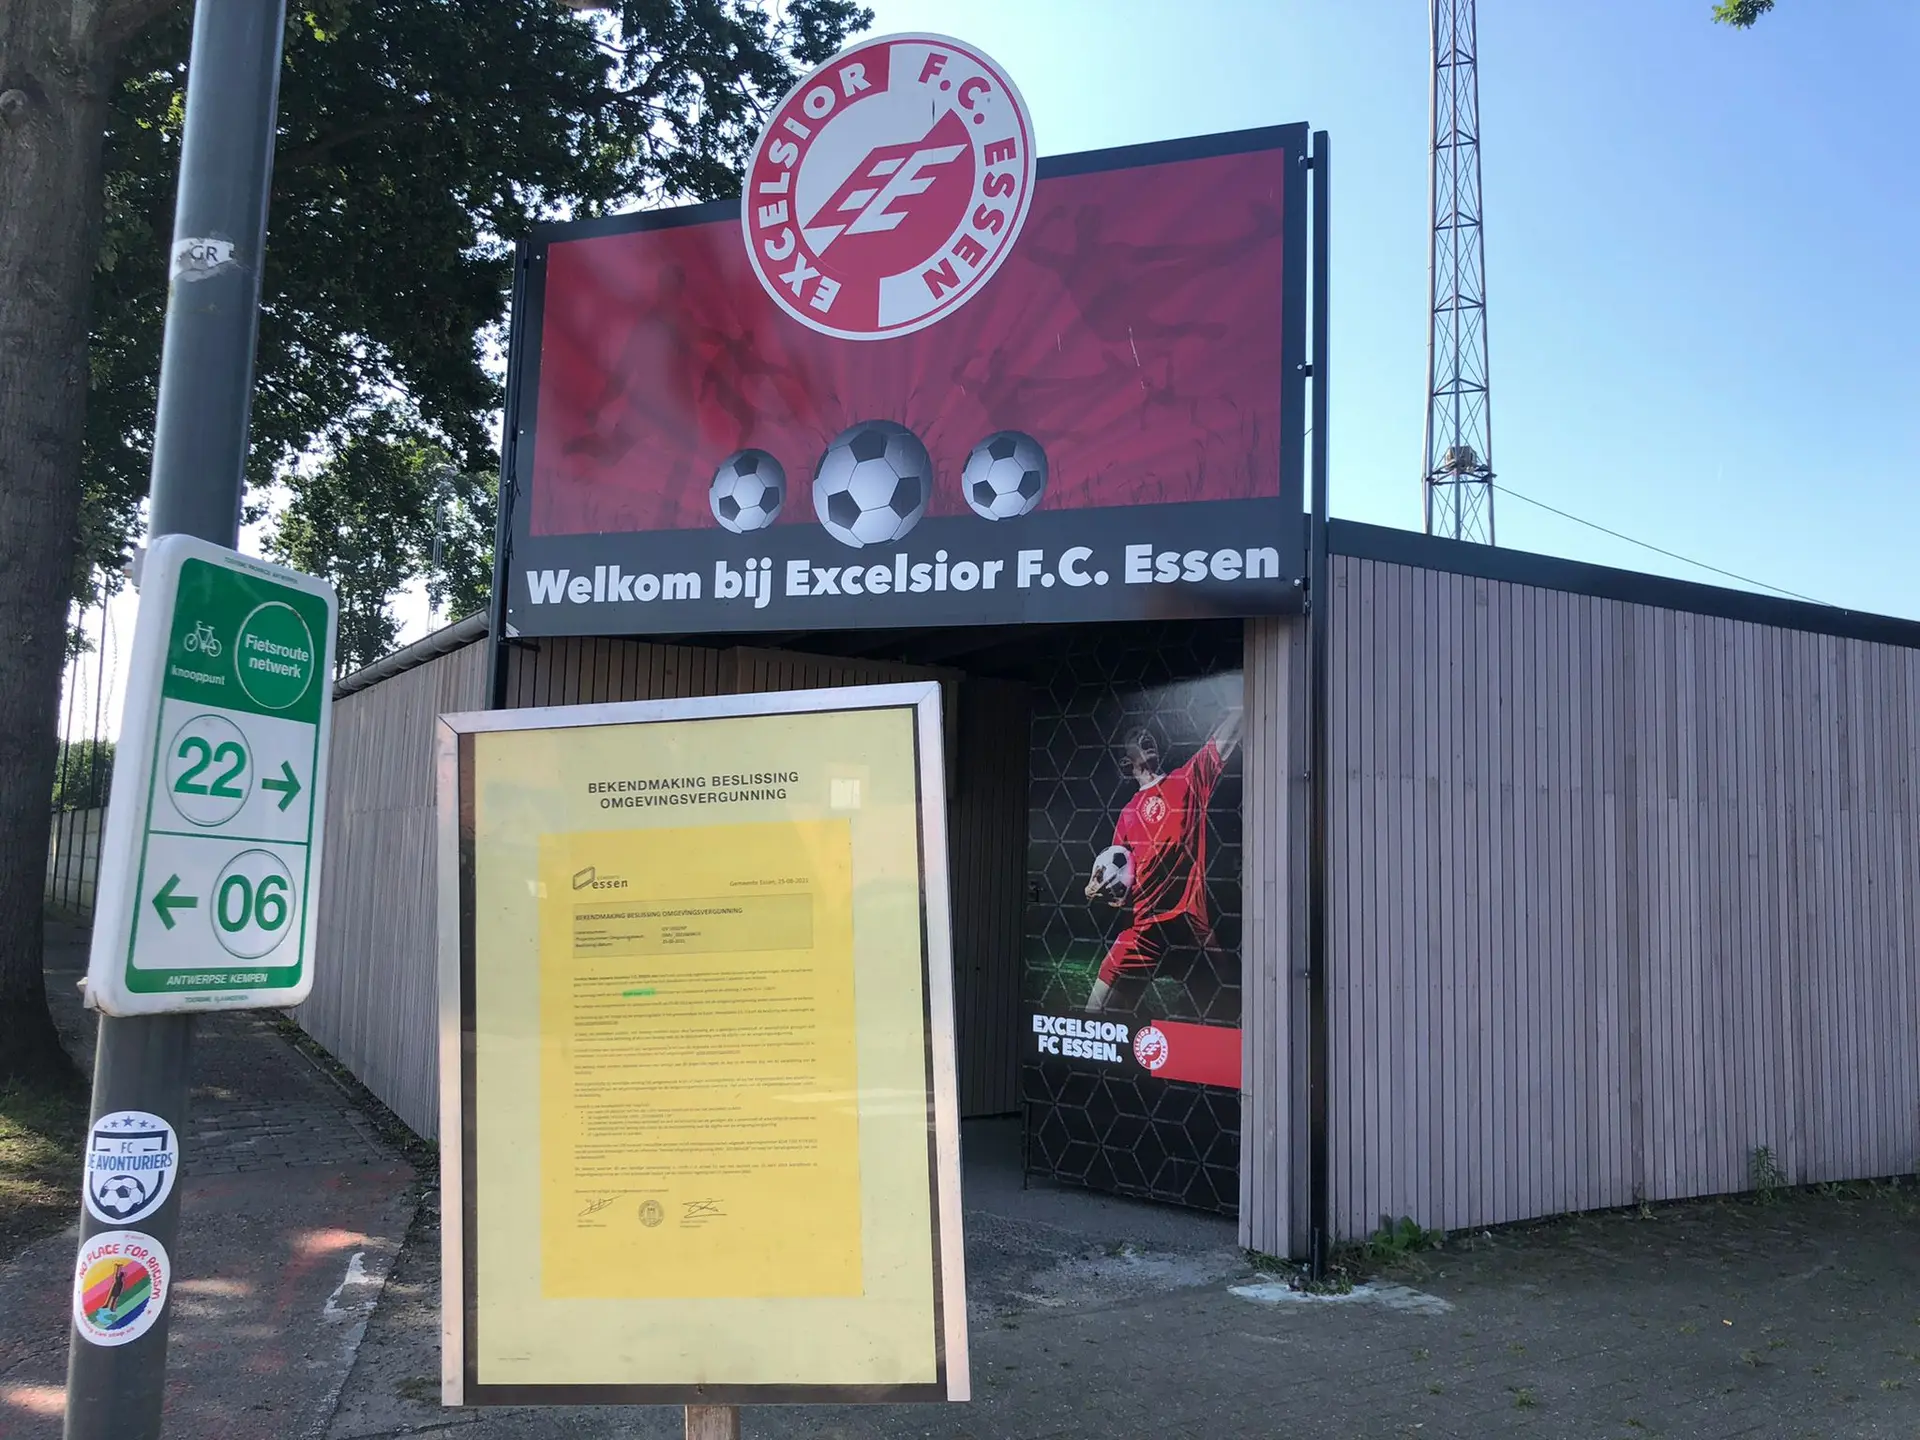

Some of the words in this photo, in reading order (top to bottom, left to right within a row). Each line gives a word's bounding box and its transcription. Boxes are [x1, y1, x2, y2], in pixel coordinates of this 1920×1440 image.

[918, 52, 991, 125] F.C.
[758, 62, 872, 314] EXCELSIOR
[922, 137, 1016, 300] ESSEN
[526, 564, 701, 605] Welkom
[714, 556, 773, 609] bij
[785, 549, 1004, 597] Excelsior
[1017, 546, 1110, 588] F.C.
[1124, 543, 1280, 585] Essen
[245, 633, 309, 662] Fietsroute
[171, 665, 226, 686] knooppunt
[248, 655, 301, 679] netwerk
[173, 736, 246, 799] 22
[588, 776, 707, 794] BEKENDMAKING
[711, 771, 799, 788] BESLISSING
[600, 788, 787, 809] OMGEVINGSVERGUNNING
[592, 879, 629, 890] essen
[217, 874, 288, 932] 06
[167, 974, 227, 986] ANTWERPSE
[230, 973, 268, 983] KEMPEN
[1032, 1014, 1130, 1043] EXCELSIOR
[1038, 1034, 1060, 1055] FC
[1062, 1037, 1123, 1064] ESSEN.
[96, 1152, 173, 1171] AVONTURIERS
[120, 1141, 133, 1154] FC
[79, 1261, 88, 1279] NO
[87, 1243, 120, 1262] PLACE
[124, 1244, 149, 1260] FOR
[146, 1256, 162, 1300] RACISM
